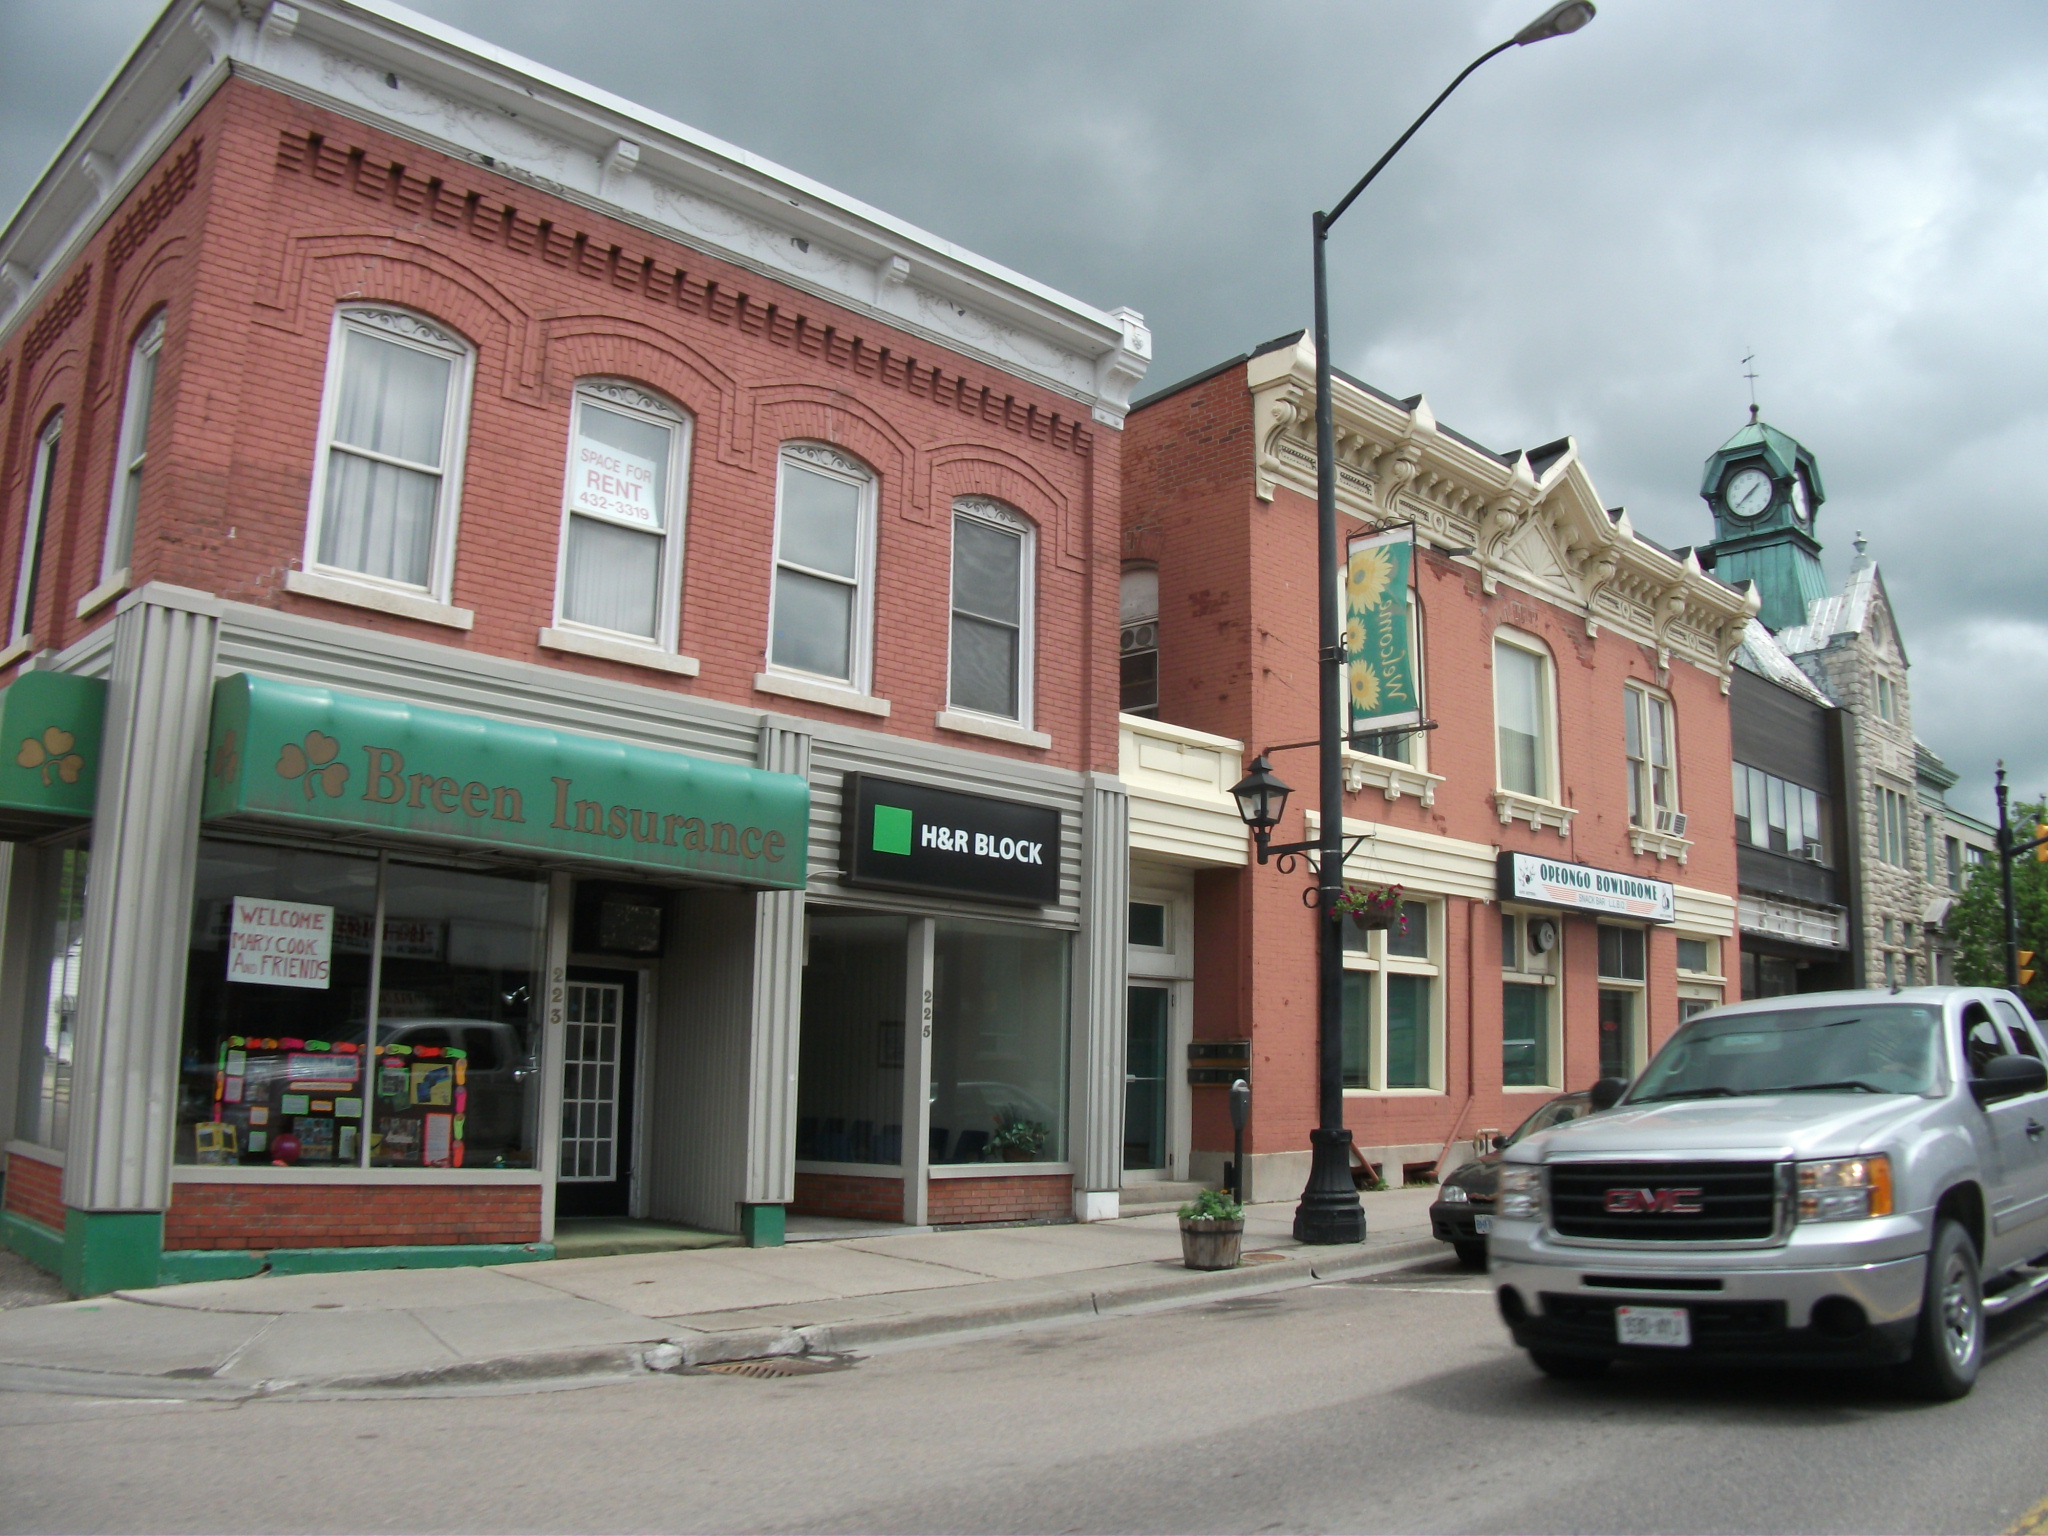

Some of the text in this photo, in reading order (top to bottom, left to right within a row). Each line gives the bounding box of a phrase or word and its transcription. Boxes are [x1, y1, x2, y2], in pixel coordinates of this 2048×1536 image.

[580, 448, 652, 483] SPACE FOR
[587, 469, 643, 502] RENT
[580, 491, 649, 520] 432-3319
[362, 745, 786, 863] Breen Insurance
[921, 823, 1043, 865] H&R BLOCK
[1540, 863, 1658, 901] OPEONGO BOWLDROME
[240, 906, 325, 930] WELCOME
[232, 932, 318, 955] MARY COOK
[260, 955, 330, 980] FRIENDS
[550, 967, 564, 1024] 223
[923, 989, 932, 1038] 225
[1604, 1188, 1703, 1213] GMC
